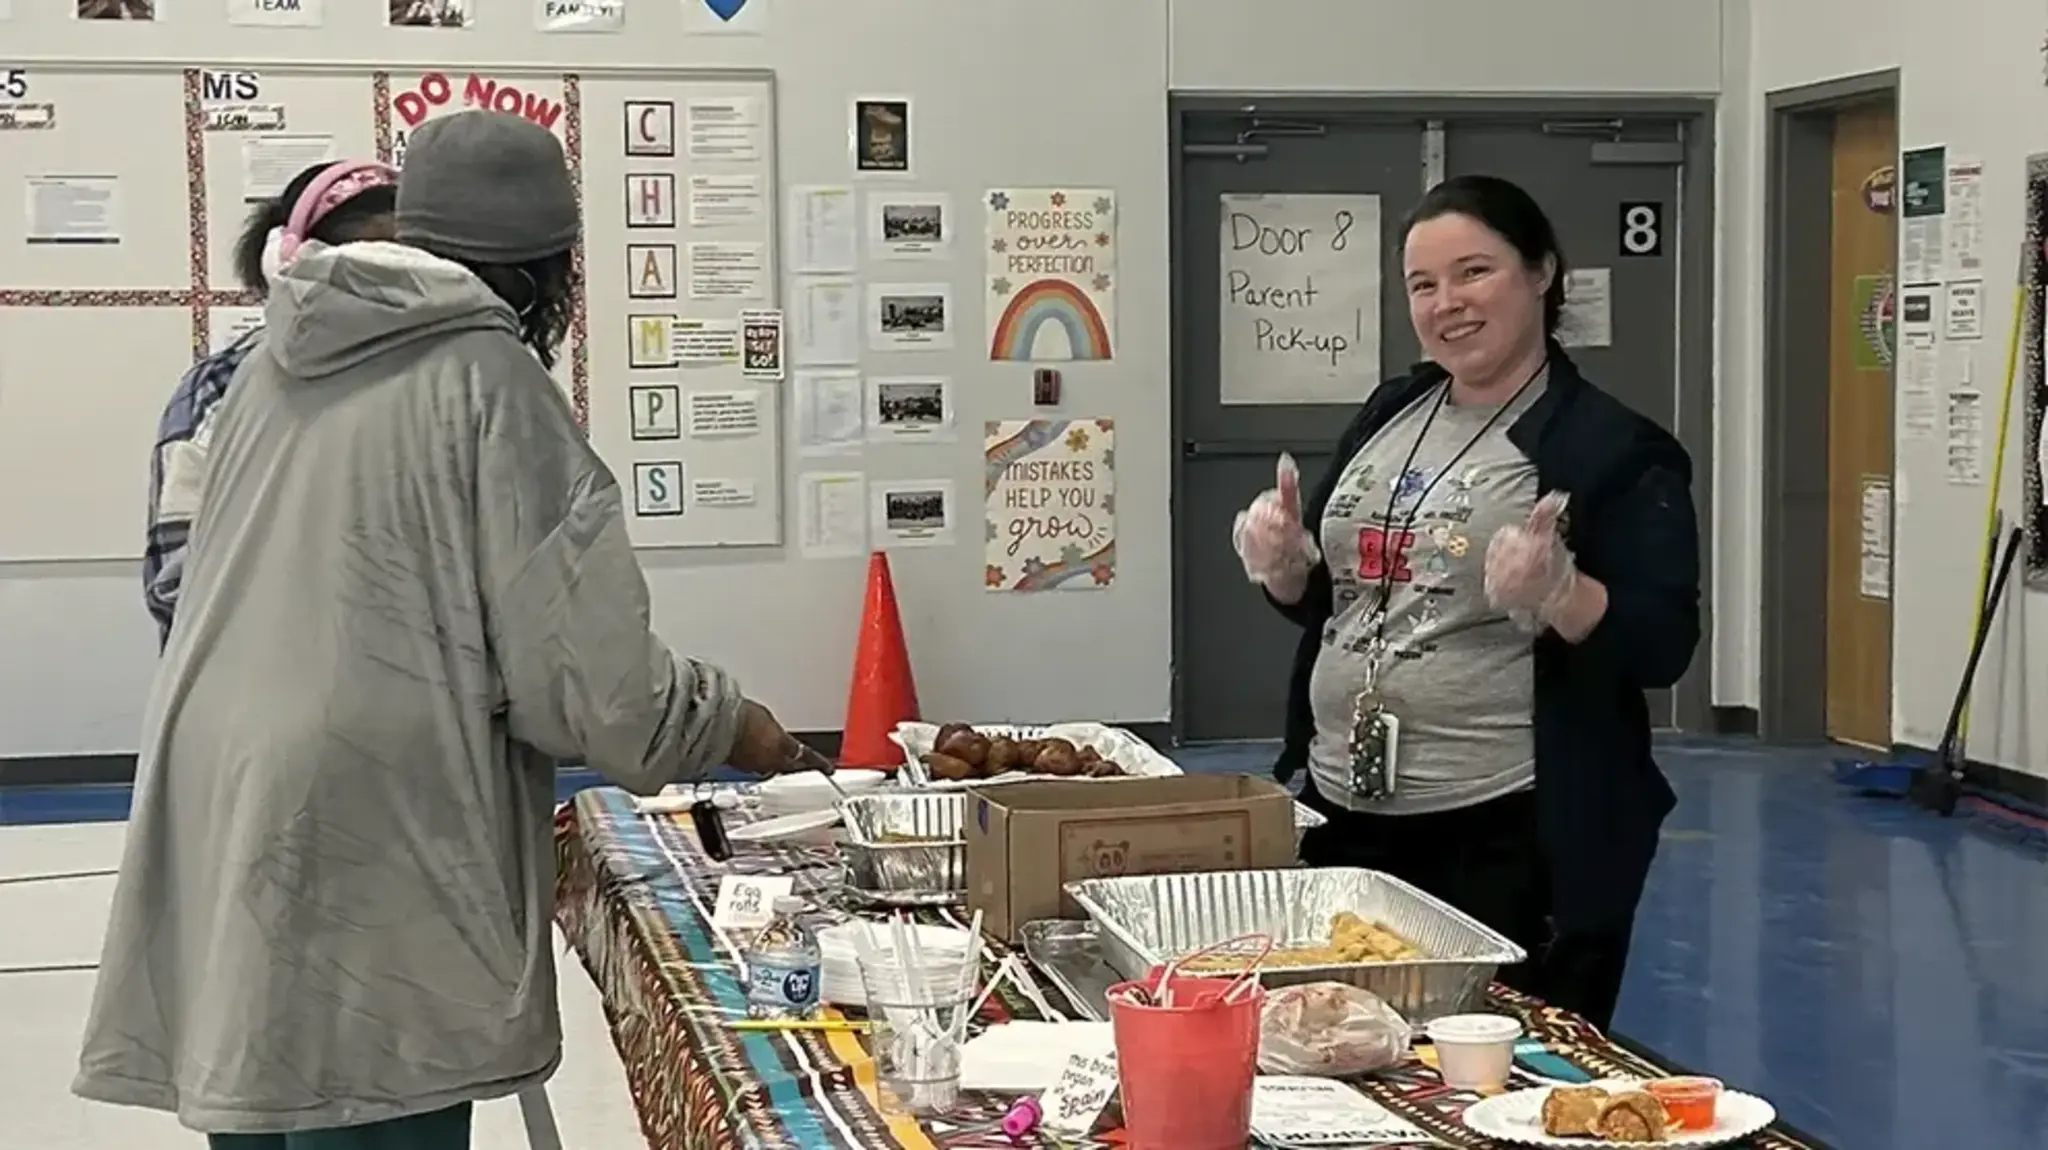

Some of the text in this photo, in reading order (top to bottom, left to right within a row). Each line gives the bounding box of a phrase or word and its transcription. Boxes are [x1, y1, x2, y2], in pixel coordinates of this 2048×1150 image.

[545, 2, 613, 17] FAMY!
[203, 72, 259, 100] MS
[393, 72, 562, 127] DO NOW
[639, 106, 657, 143] C
[640, 179, 661, 216] H
[1008, 210, 1093, 230] PROGRESS
[1231, 210, 1353, 255] Door 8
[1624, 206, 1658, 253] 8
[1017, 233, 1088, 250] over
[641, 249, 663, 287] A
[1008, 254, 1093, 273] PERFECTION
[1229, 269, 1318, 309] Parent
[641, 319, 663, 358] M
[647, 391, 663, 426] P
[648, 467, 667, 502] S
[1004, 460, 1094, 481] MISTAKES
[1006, 487, 1095, 508] HELP YOU
[1008, 513, 1093, 556] grow
[1358, 527, 1415, 582] BE
[729, 898, 760, 914] rolls
[732, 882, 762, 903] Egg
